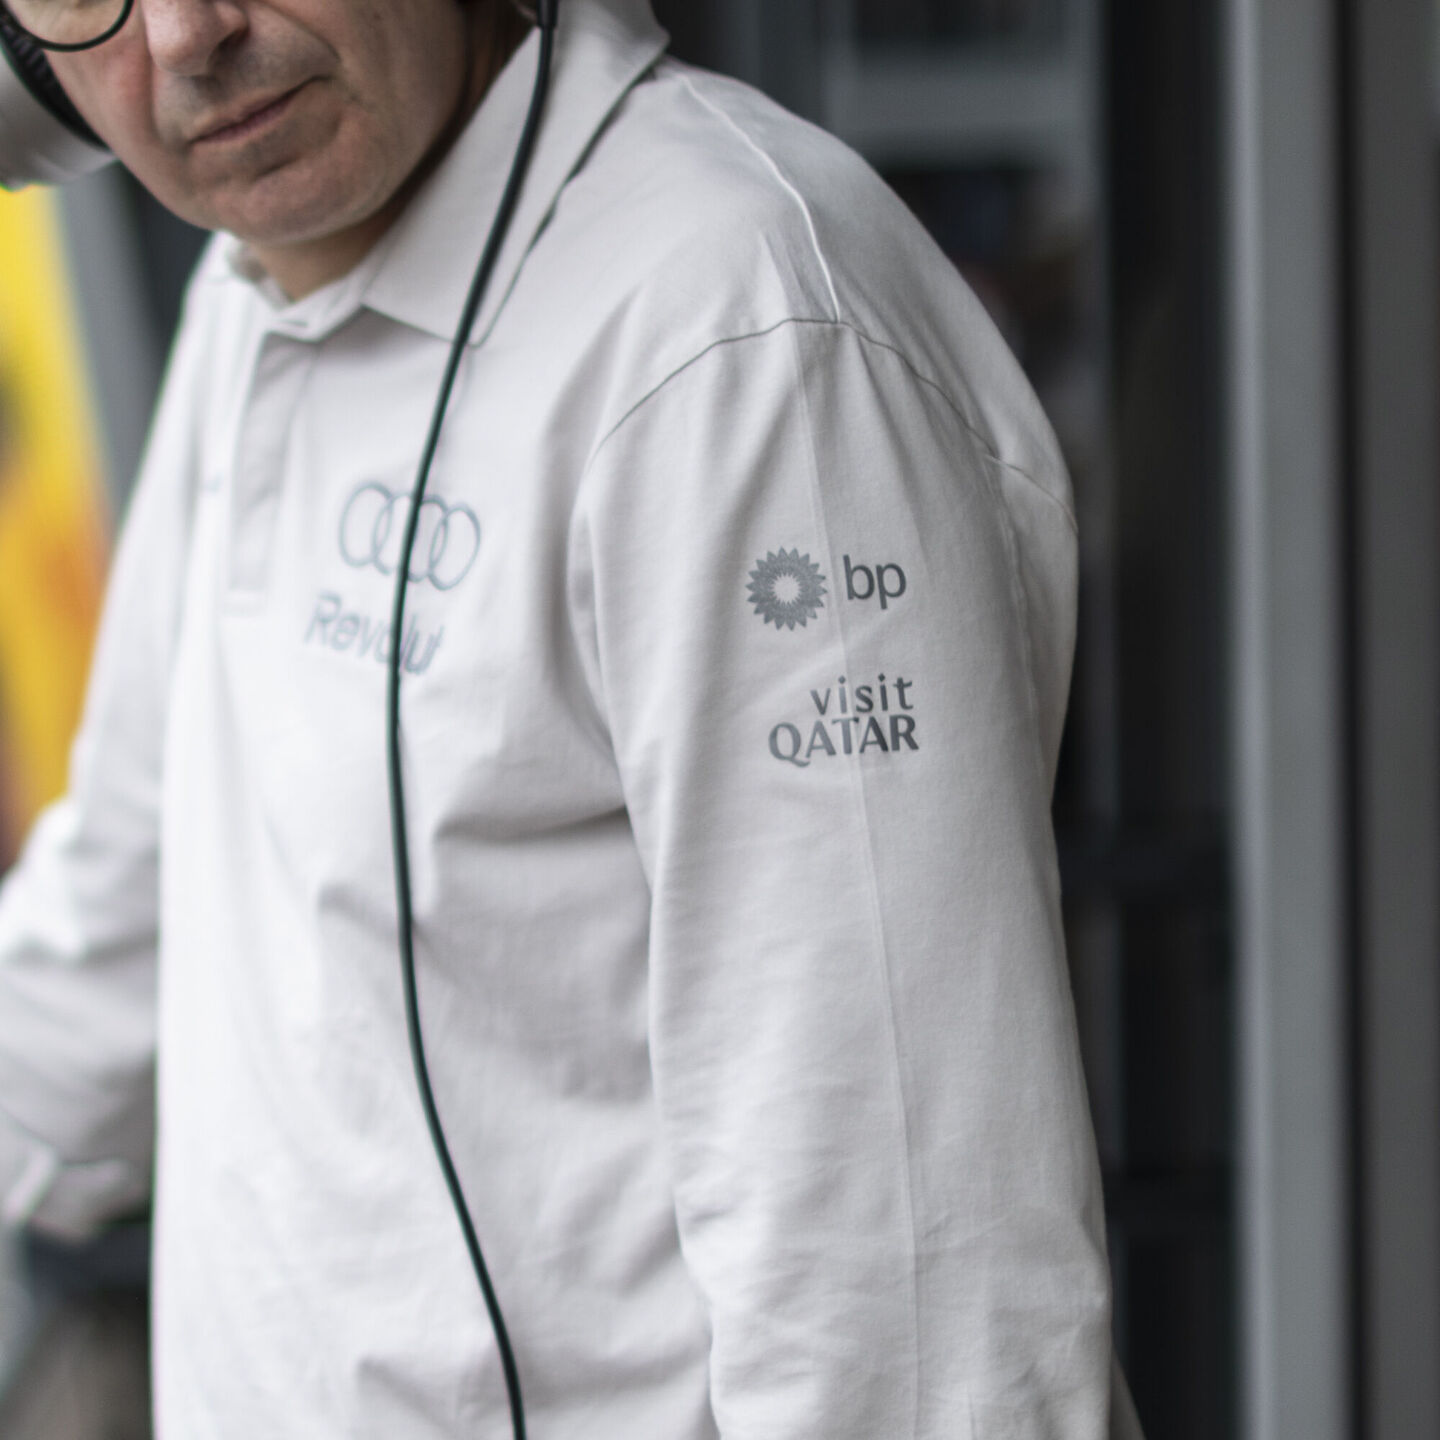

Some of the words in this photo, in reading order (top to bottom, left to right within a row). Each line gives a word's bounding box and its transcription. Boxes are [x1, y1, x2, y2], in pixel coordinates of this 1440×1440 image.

[842, 554, 907, 610] bp
[810, 672, 914, 716] visit
[767, 713, 920, 768] QATAR
